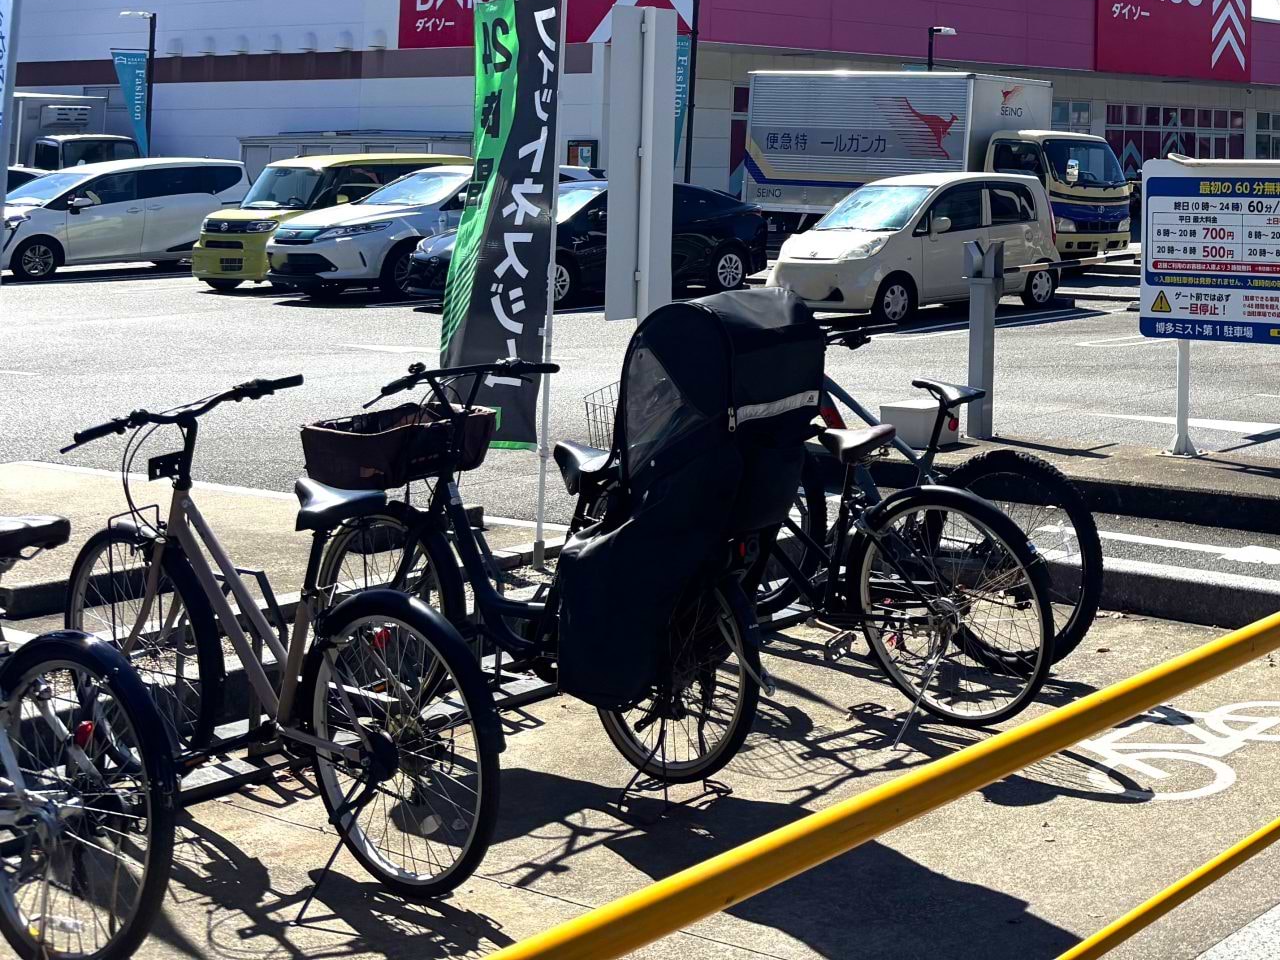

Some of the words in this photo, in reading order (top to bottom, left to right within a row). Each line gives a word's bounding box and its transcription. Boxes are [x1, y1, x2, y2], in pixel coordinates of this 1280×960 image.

[1111, 2, 1150, 20] ダイソー
[416, 17, 455, 32] ダイソー
[134, 69, 145, 120] Fashion
[1000, 106, 1023, 117] SEINO
[757, 188, 782, 198] SEINO
[1202, 227, 1234, 240] 700円
[1202, 246, 1234, 259] 500円
[1174, 292, 1231, 302] ゲート前では必ず
